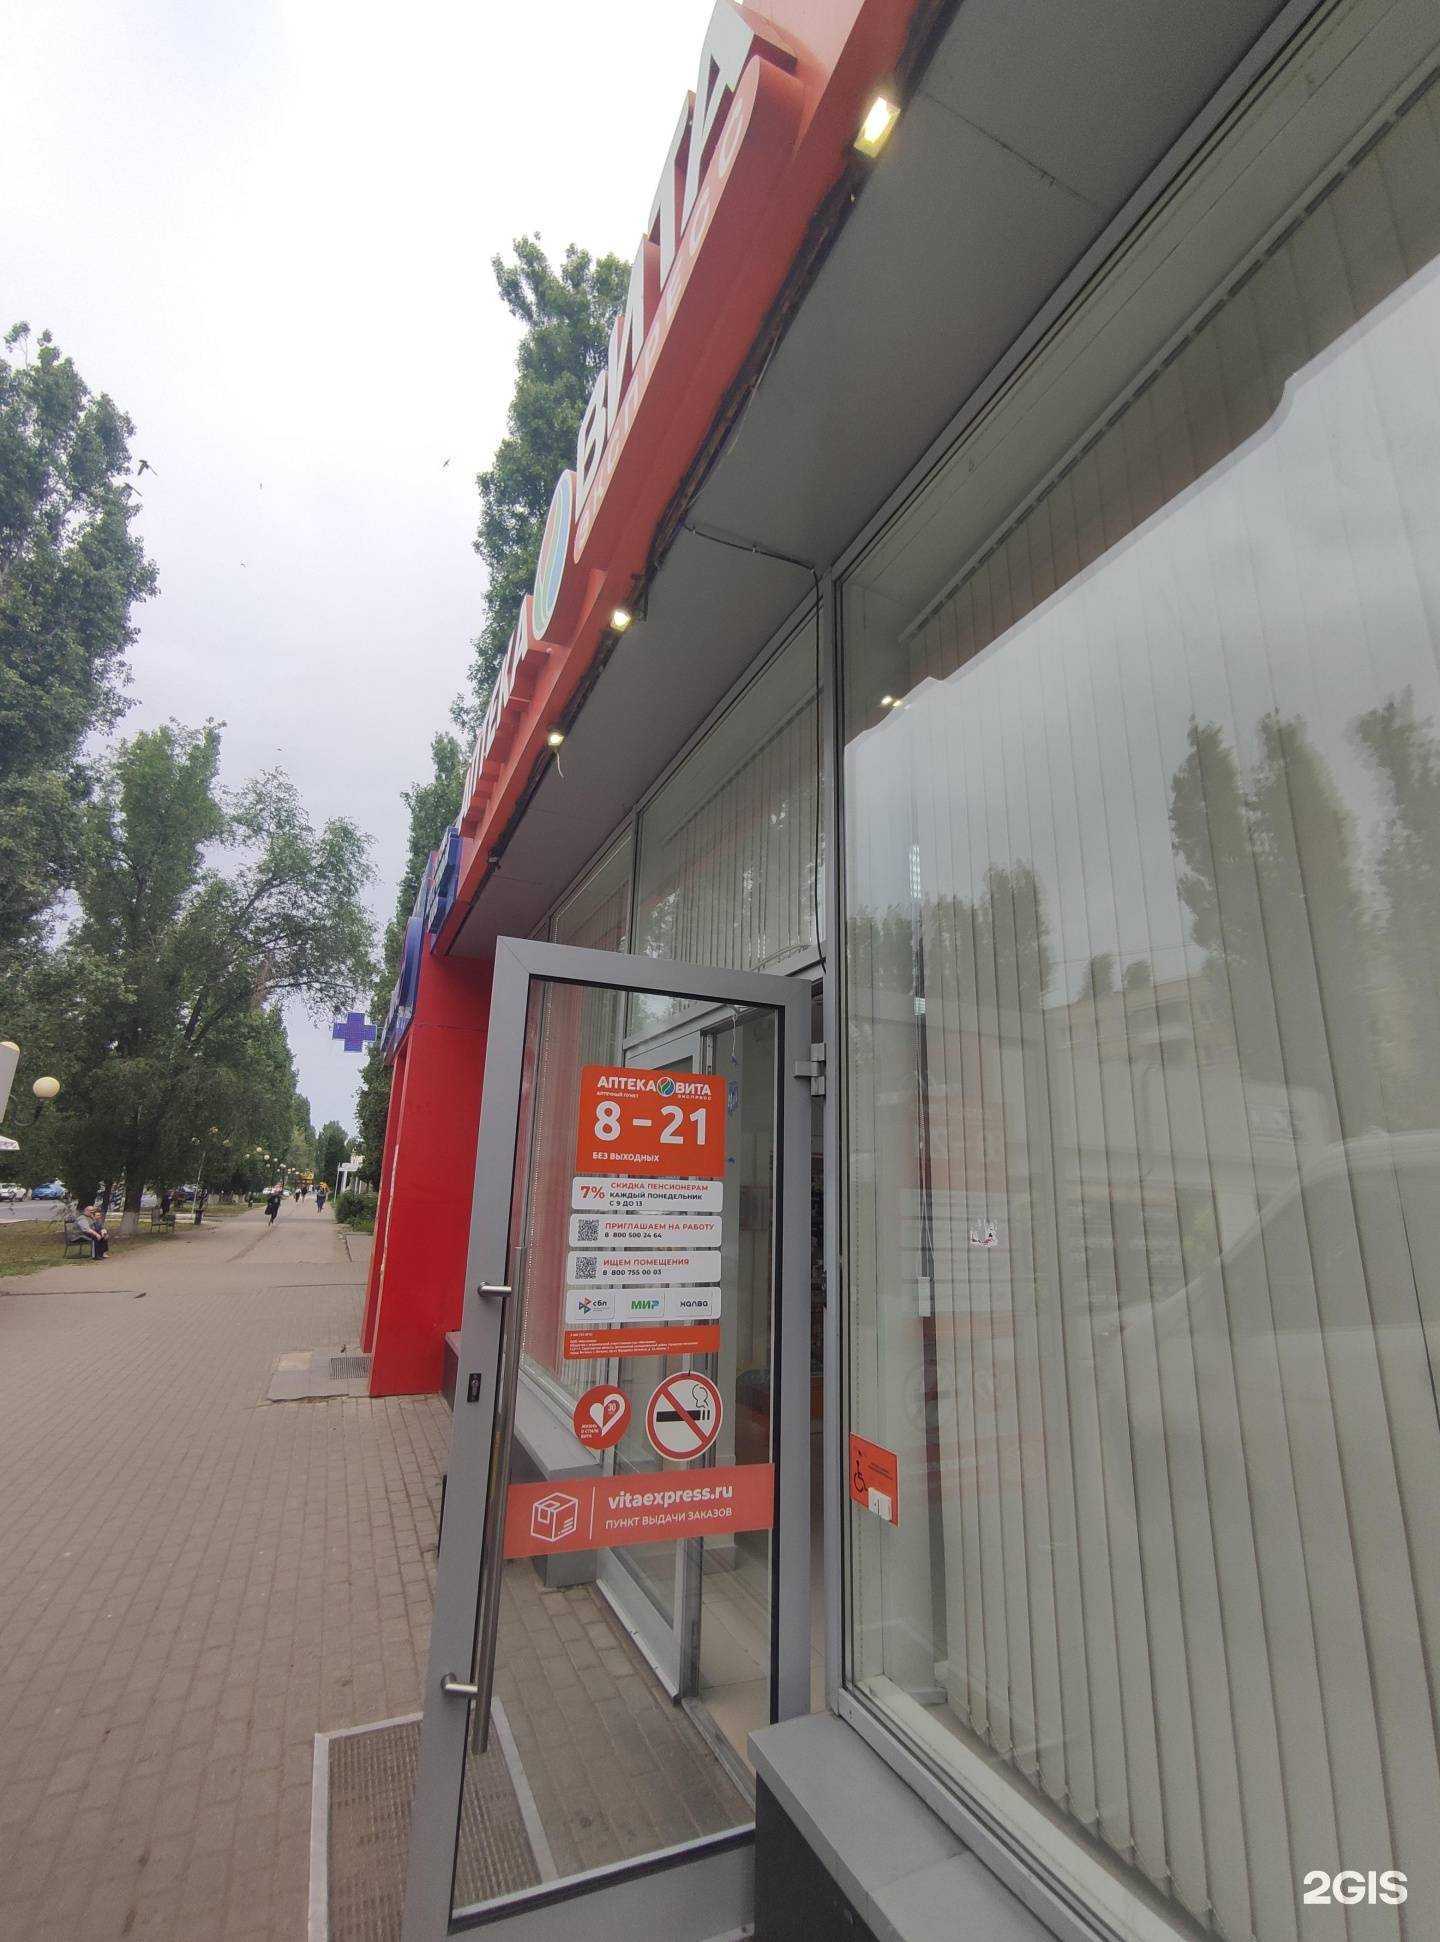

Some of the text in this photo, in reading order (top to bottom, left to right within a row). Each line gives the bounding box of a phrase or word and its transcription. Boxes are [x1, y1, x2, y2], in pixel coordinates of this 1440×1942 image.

[575, 0, 755, 524] ВИТА
[597, 1076, 712, 1096] АПТЕКА ВИТА
[594, 1100, 621, 1142] 8
[659, 1105, 707, 1146] 21
[592, 1151, 660, 1163] БЕЗ ВЫХОДНЫХ
[580, 1185, 605, 1200] 7%
[610, 1182, 709, 1192] СКИДКА ПЕНСИОНЕРАМ
[609, 1191, 703, 1201] КАЖДЫЙ ПОНЕДЕЛЬНИК
[605, 1222, 715, 1231] ПРИГЛАШАЕМ НА РАБОТУ
[603, 1258, 690, 1267] ИЩЕМ ПОМЕЩЕНИЯ
[631, 1300, 660, 1310] МИР
[608, 1485, 734, 1510] vitaexpress.ru
[605, 1507, 733, 1530] ПУНКТ ВЫДАЧИ ЗАКАЗОВ
